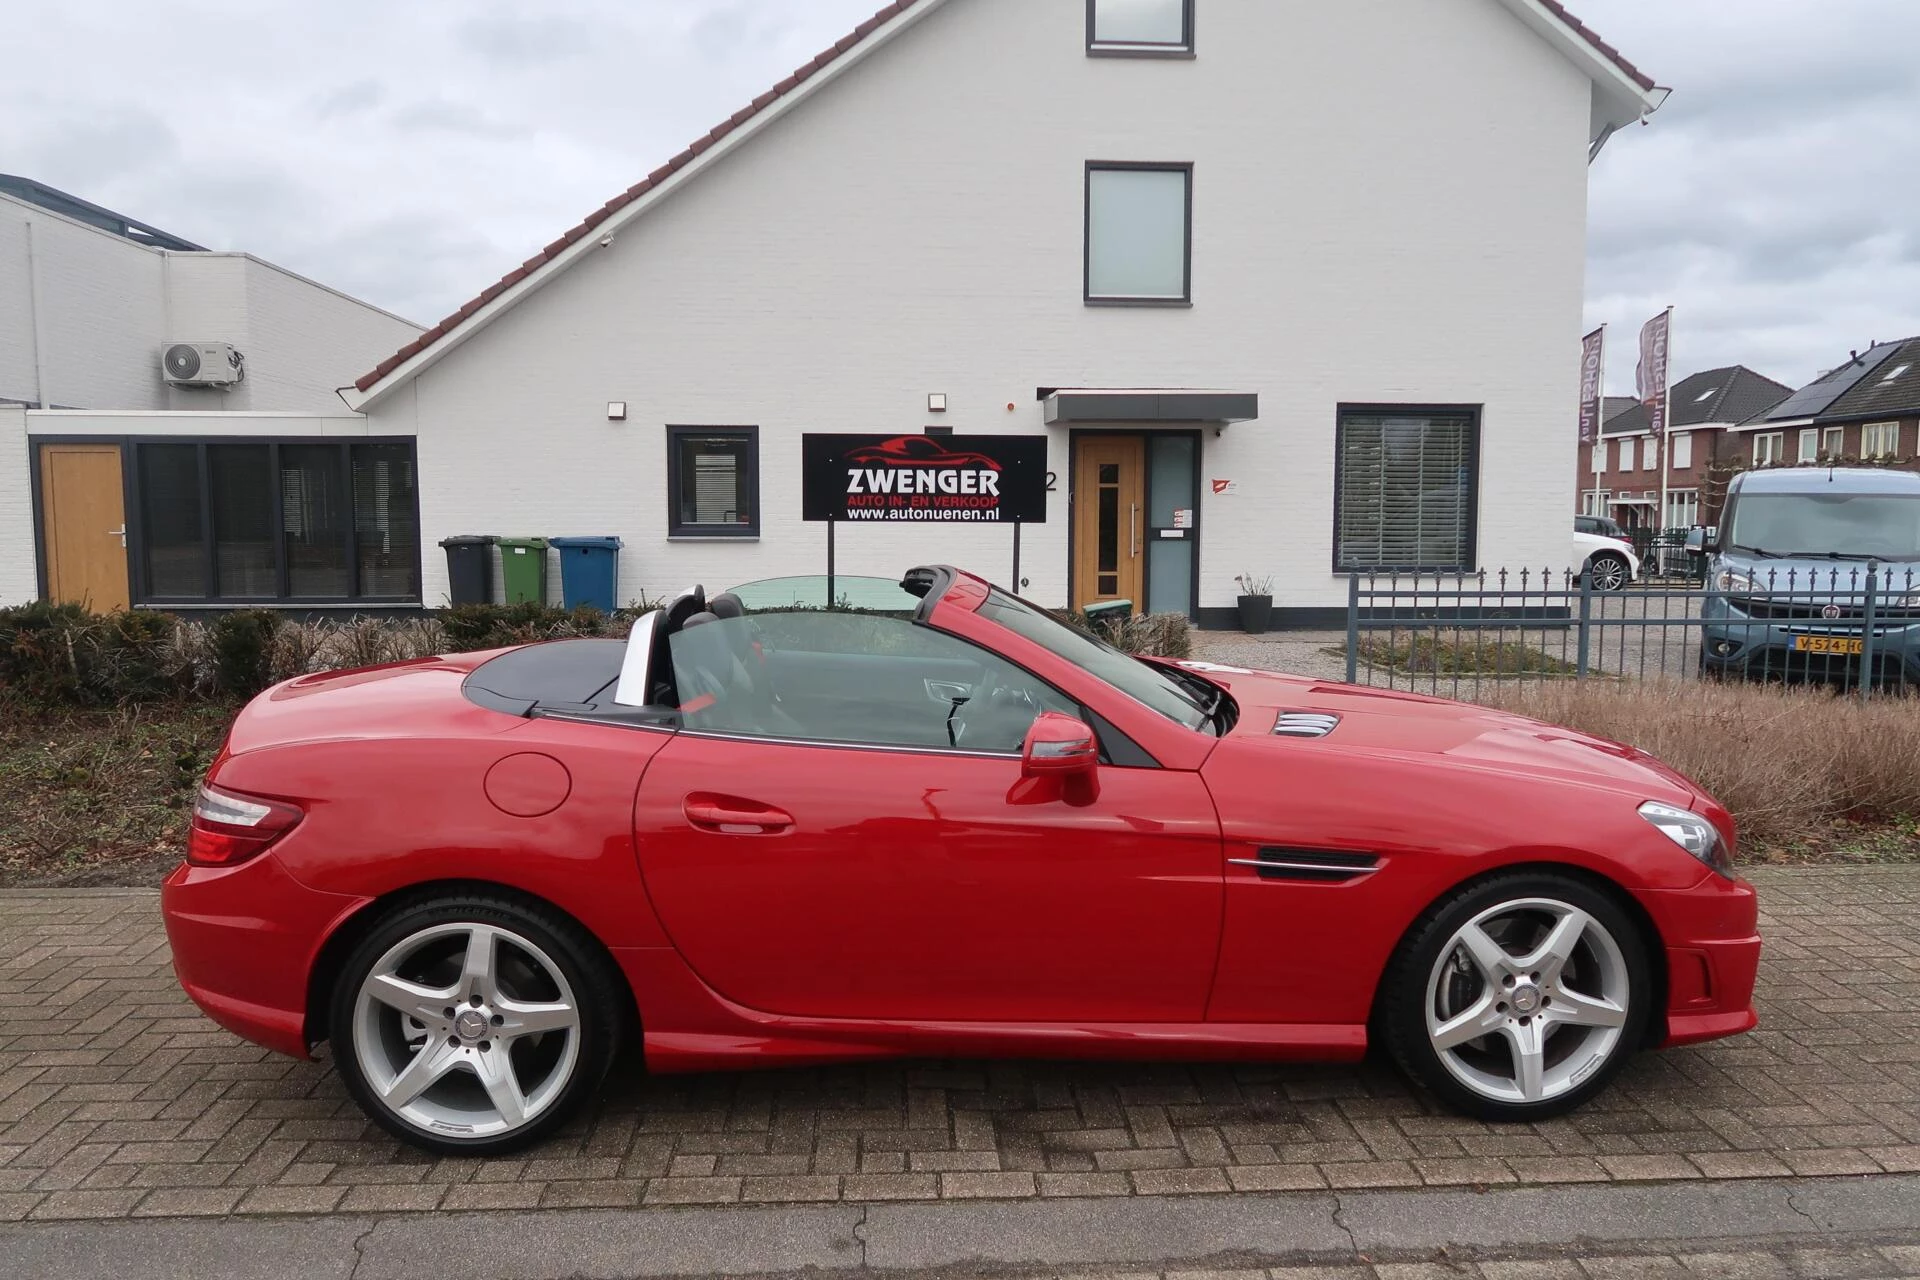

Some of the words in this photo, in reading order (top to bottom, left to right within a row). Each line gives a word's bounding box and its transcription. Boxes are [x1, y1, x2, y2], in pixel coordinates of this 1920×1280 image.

[847, 468, 1000, 497] ZWENGER
[847, 495, 884, 507] AUTO
[888, 496, 907, 507] IN-
[911, 496, 930, 507] EN
[931, 496, 999, 508] VERKOOP
[847, 507, 1000, 520] www.autonuenen.nl
